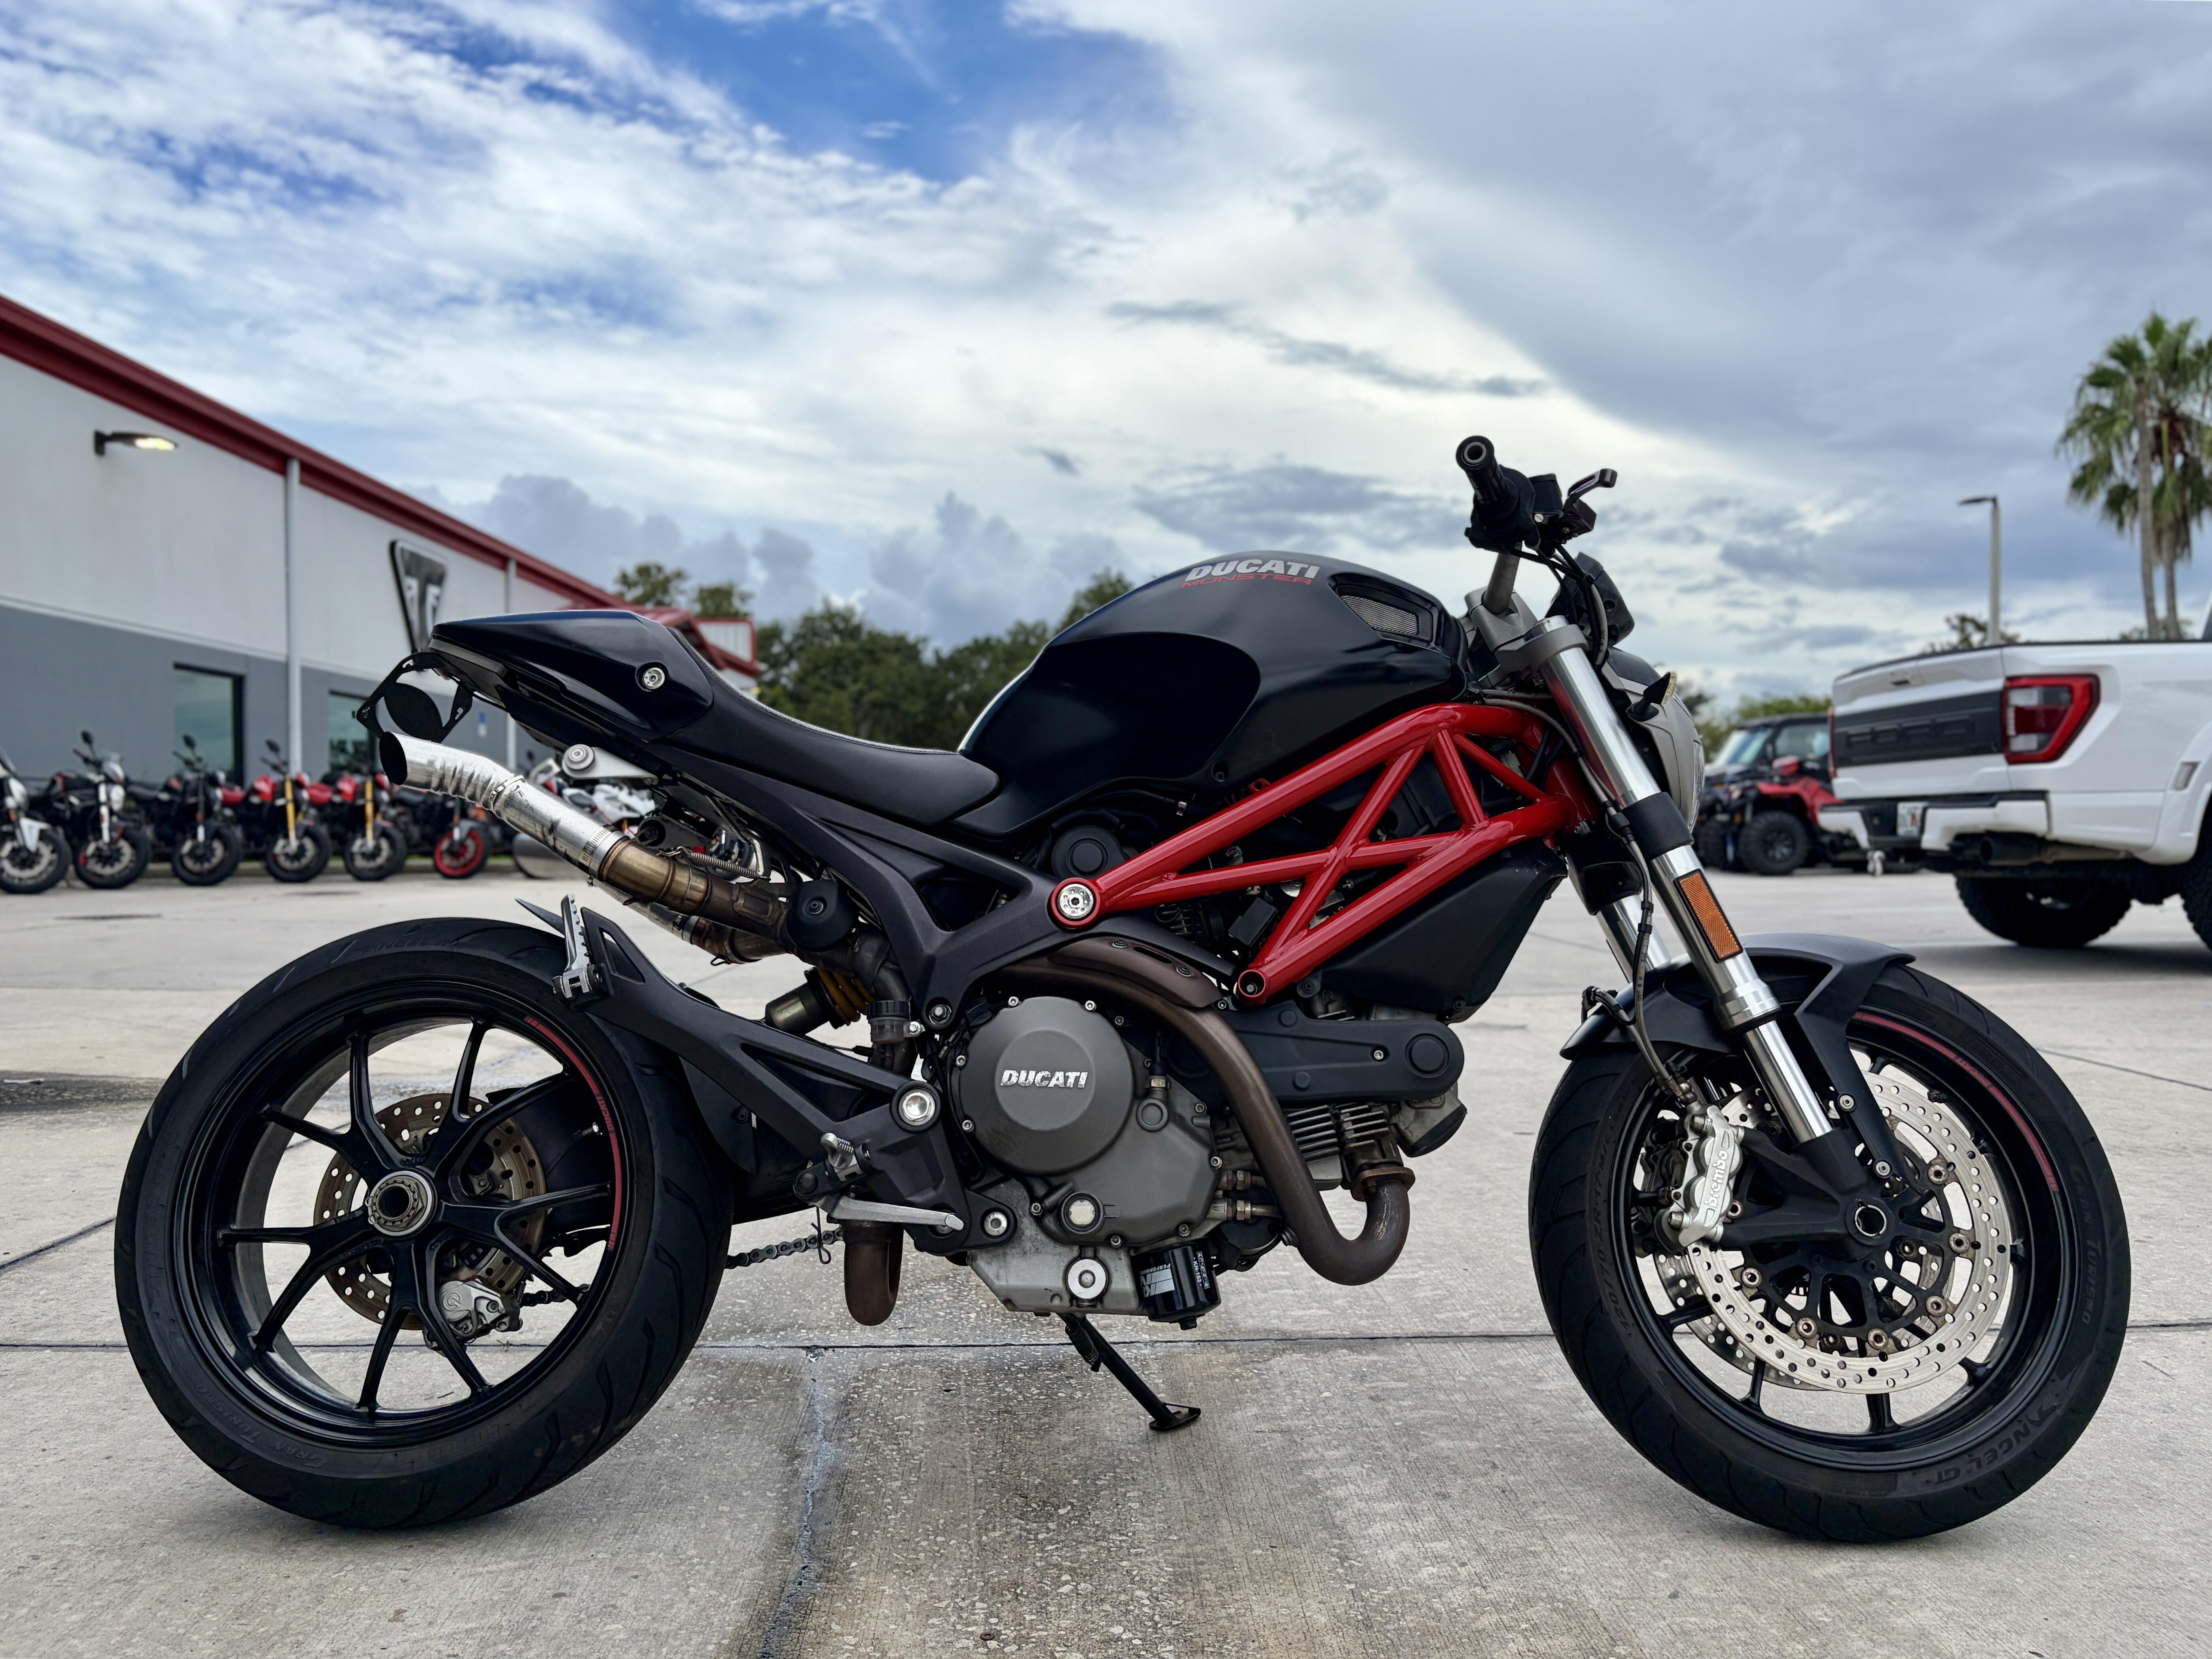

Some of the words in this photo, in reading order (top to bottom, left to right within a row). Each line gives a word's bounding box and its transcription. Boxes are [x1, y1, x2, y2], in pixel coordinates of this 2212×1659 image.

[1181, 573, 1312, 589] MONSTER
[1185, 559, 1320, 582] DUCATI
[1000, 1069, 1088, 1088] DUCATI
[1704, 1149, 1729, 1209] brembo
